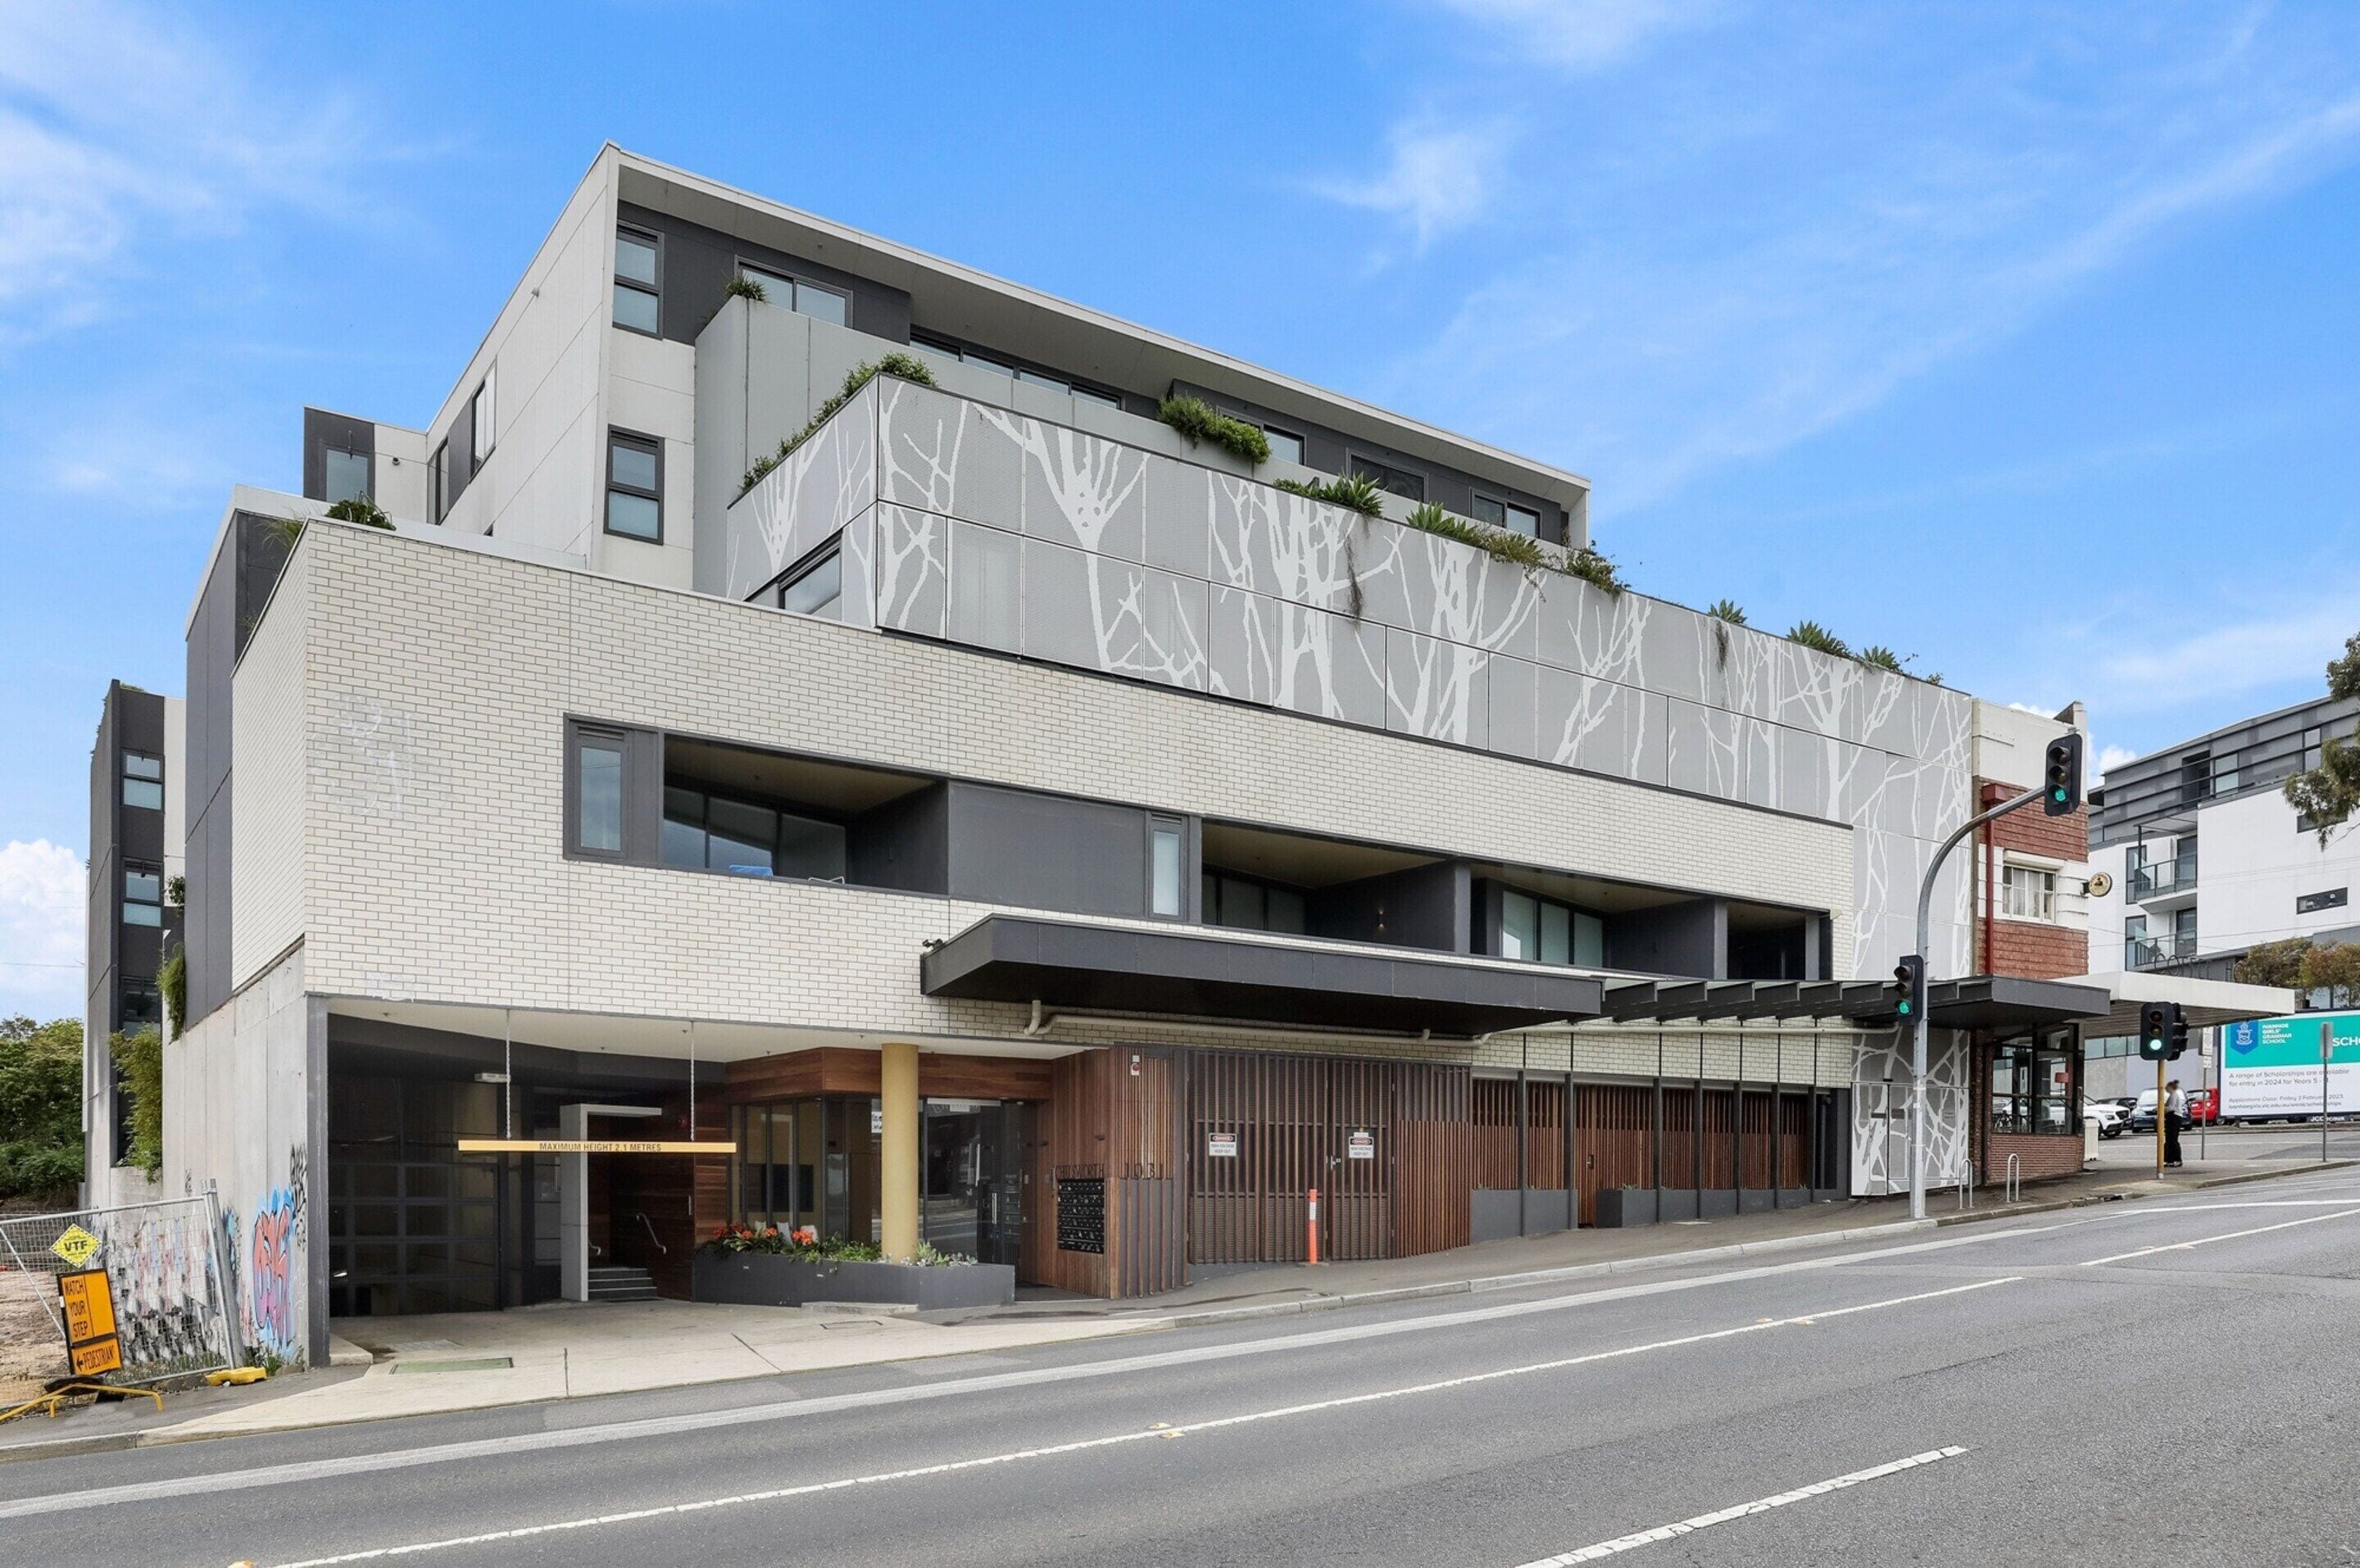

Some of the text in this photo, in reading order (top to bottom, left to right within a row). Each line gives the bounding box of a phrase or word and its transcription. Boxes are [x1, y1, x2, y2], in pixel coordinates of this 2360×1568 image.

[2332, 1036, 2360, 1047] SCH
[2263, 1070, 2305, 1078] Scholarships
[2319, 1067, 2350, 1076] aailable
[539, 1143, 661, 1152] MAXIMUM HEIGHT 2.1 METRES
[64, 1240, 88, 1252] VTF
[64, 1279, 84, 1295] WATCH
[68, 1300, 86, 1317] YOUR
[72, 1321, 88, 1338] STEP
